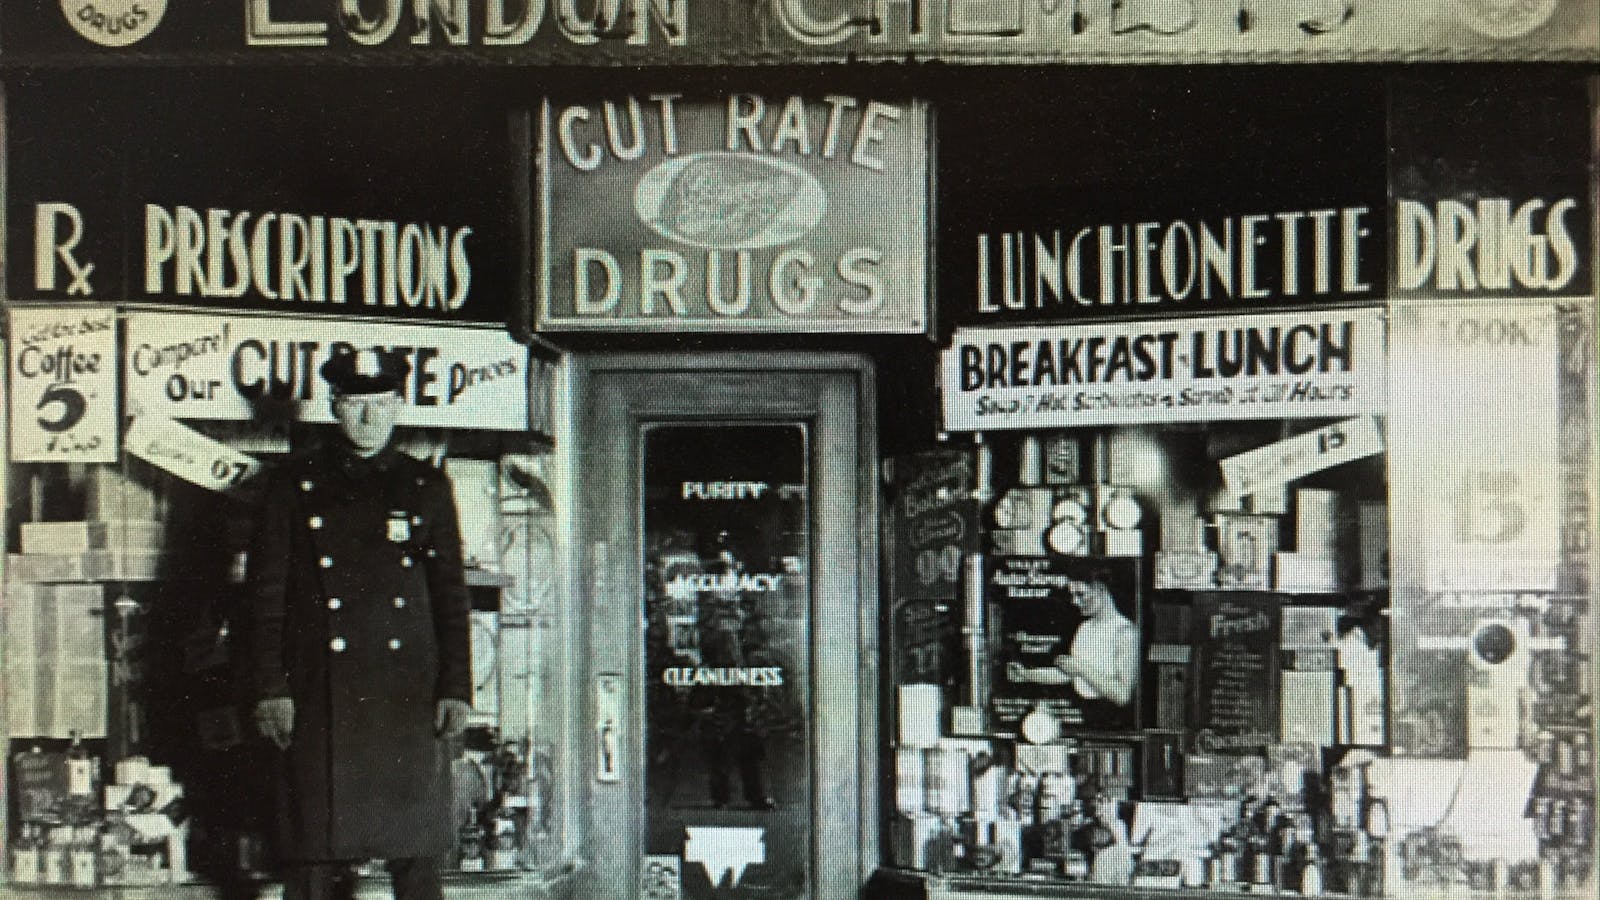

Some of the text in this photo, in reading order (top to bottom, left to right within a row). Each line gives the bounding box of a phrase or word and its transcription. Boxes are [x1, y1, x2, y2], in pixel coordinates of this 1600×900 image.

[78, 2, 149, 33] DRUGS
[558, 93, 902, 171] CUT RATE
[144, 203, 473, 312] PRESCRIPTIONS
[976, 206, 1372, 313] LUNCHEONETTE
[1397, 198, 1579, 292] DRUGS
[573, 246, 885, 316] DRUGS
[17, 344, 101, 381] Coffee
[231, 340, 319, 400] CUT
[681, 480, 768, 500] PURITY
[673, 573, 782, 593] ACCURACY
[662, 667, 784, 687] CLEANLINESS
